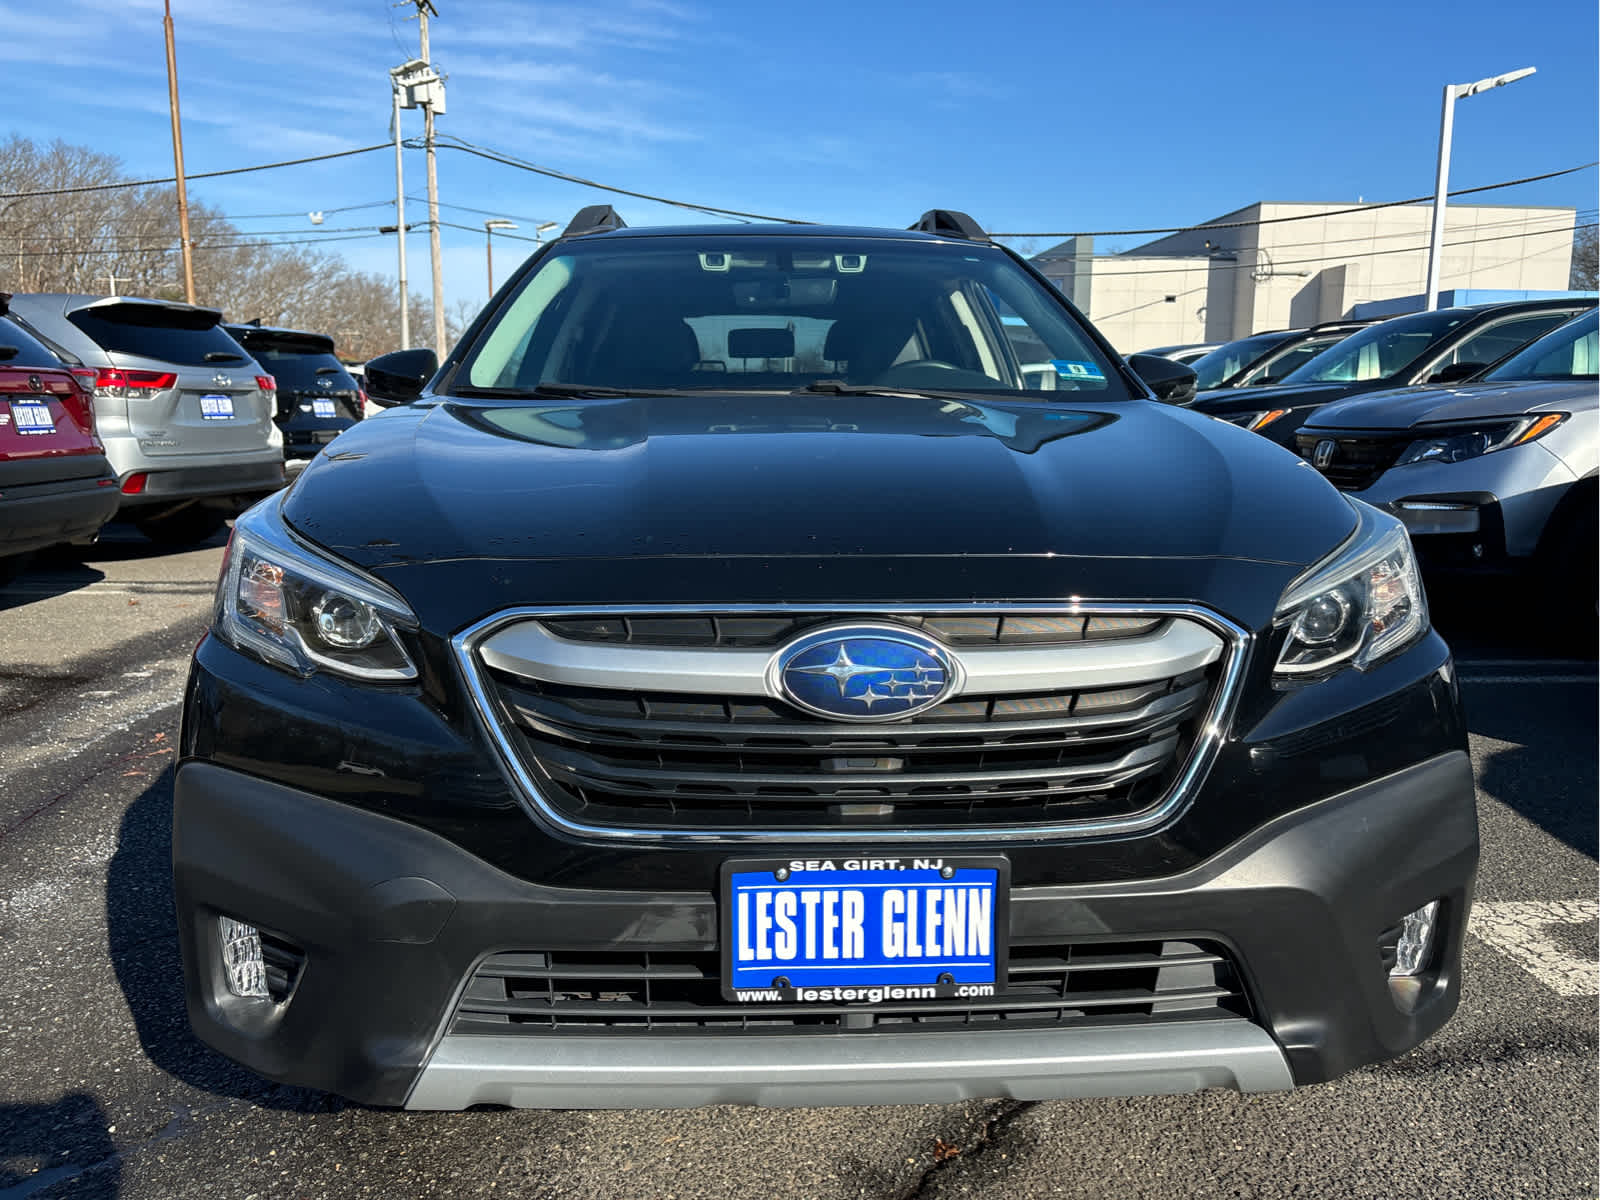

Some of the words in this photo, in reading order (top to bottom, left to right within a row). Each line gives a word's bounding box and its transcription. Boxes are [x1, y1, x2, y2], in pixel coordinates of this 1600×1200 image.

[789, 860, 835, 872] SEA
[843, 860, 906, 872] GIRT,
[913, 859, 944, 870] NJ
[738, 891, 865, 961] LESTER
[882, 888, 991, 958] GLENN
[737, 990, 782, 1001] www.
[797, 986, 936, 1002] lesterglenn
[954, 984, 995, 997] .com
